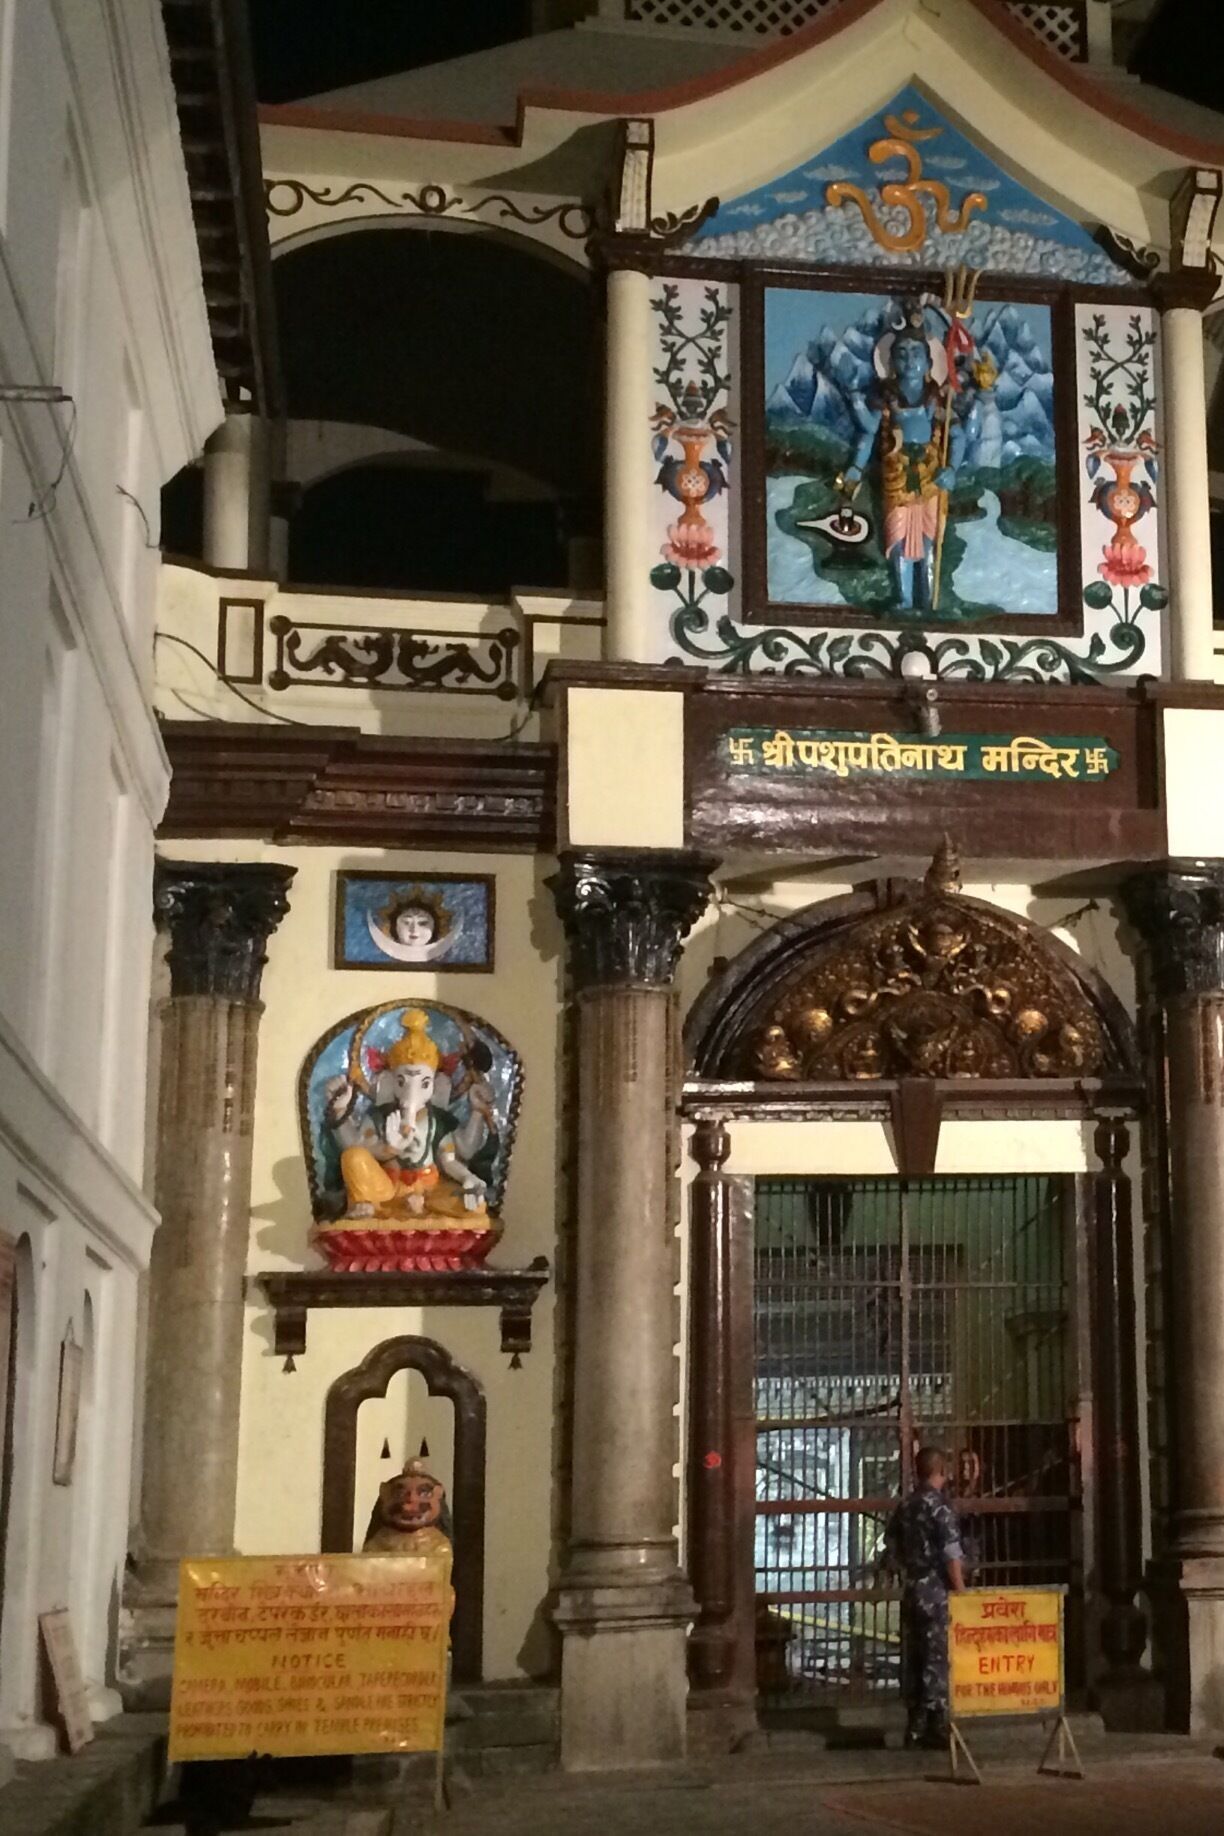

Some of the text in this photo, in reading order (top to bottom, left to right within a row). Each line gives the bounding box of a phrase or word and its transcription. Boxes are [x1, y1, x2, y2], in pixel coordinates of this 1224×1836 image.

[980, 736, 1080, 778] मन्दिर
[270, 1653, 346, 1669] NOTICE
[979, 1654, 1035, 1675] ENTRY
